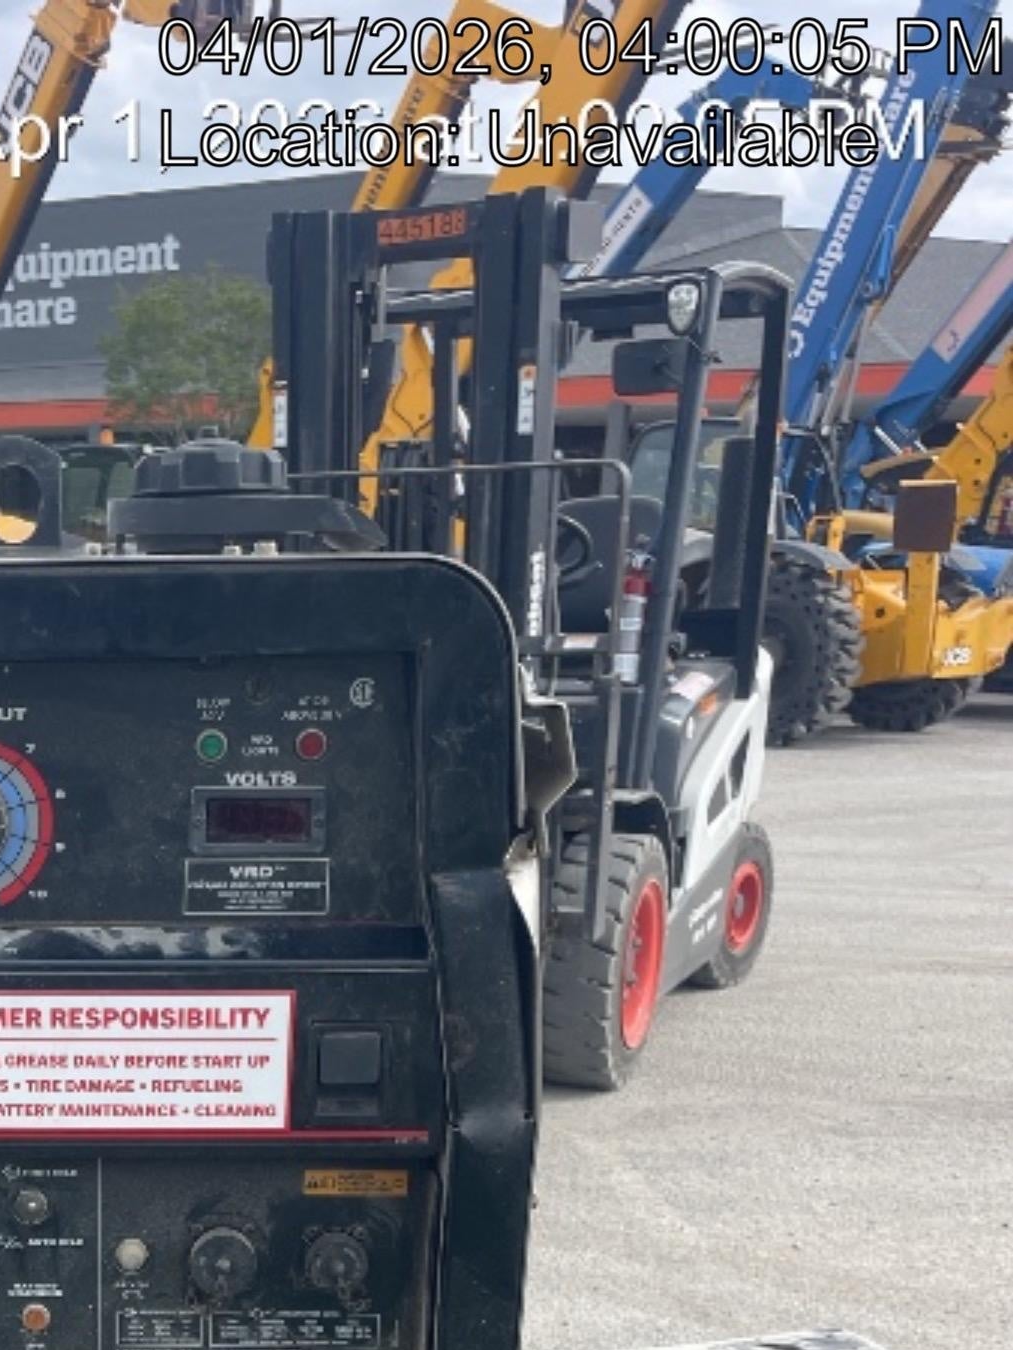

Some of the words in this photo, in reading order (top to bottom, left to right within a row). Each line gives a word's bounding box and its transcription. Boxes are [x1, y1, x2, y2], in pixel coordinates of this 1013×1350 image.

[5, 234, 181, 292] uipment
[224, 771, 298, 787] VOLTS
[49, 1007, 272, 1030] RESPONSIBILITY
[4, 1054, 69, 1069] GREASE
[73, 1054, 120, 1069] DAILY
[124, 1055, 186, 1070] BEFORE
[192, 1055, 243, 1070] START
[247, 1055, 271, 1070] UP
[25, 1079, 64, 1093] TIRE
[65, 1079, 135, 1094] DAMAGE
[150, 1079, 244, 1094] REFUELING
[58, 1103, 178, 1118] MAINTENANCE
[193, 1103, 277, 1118] CLEANING
